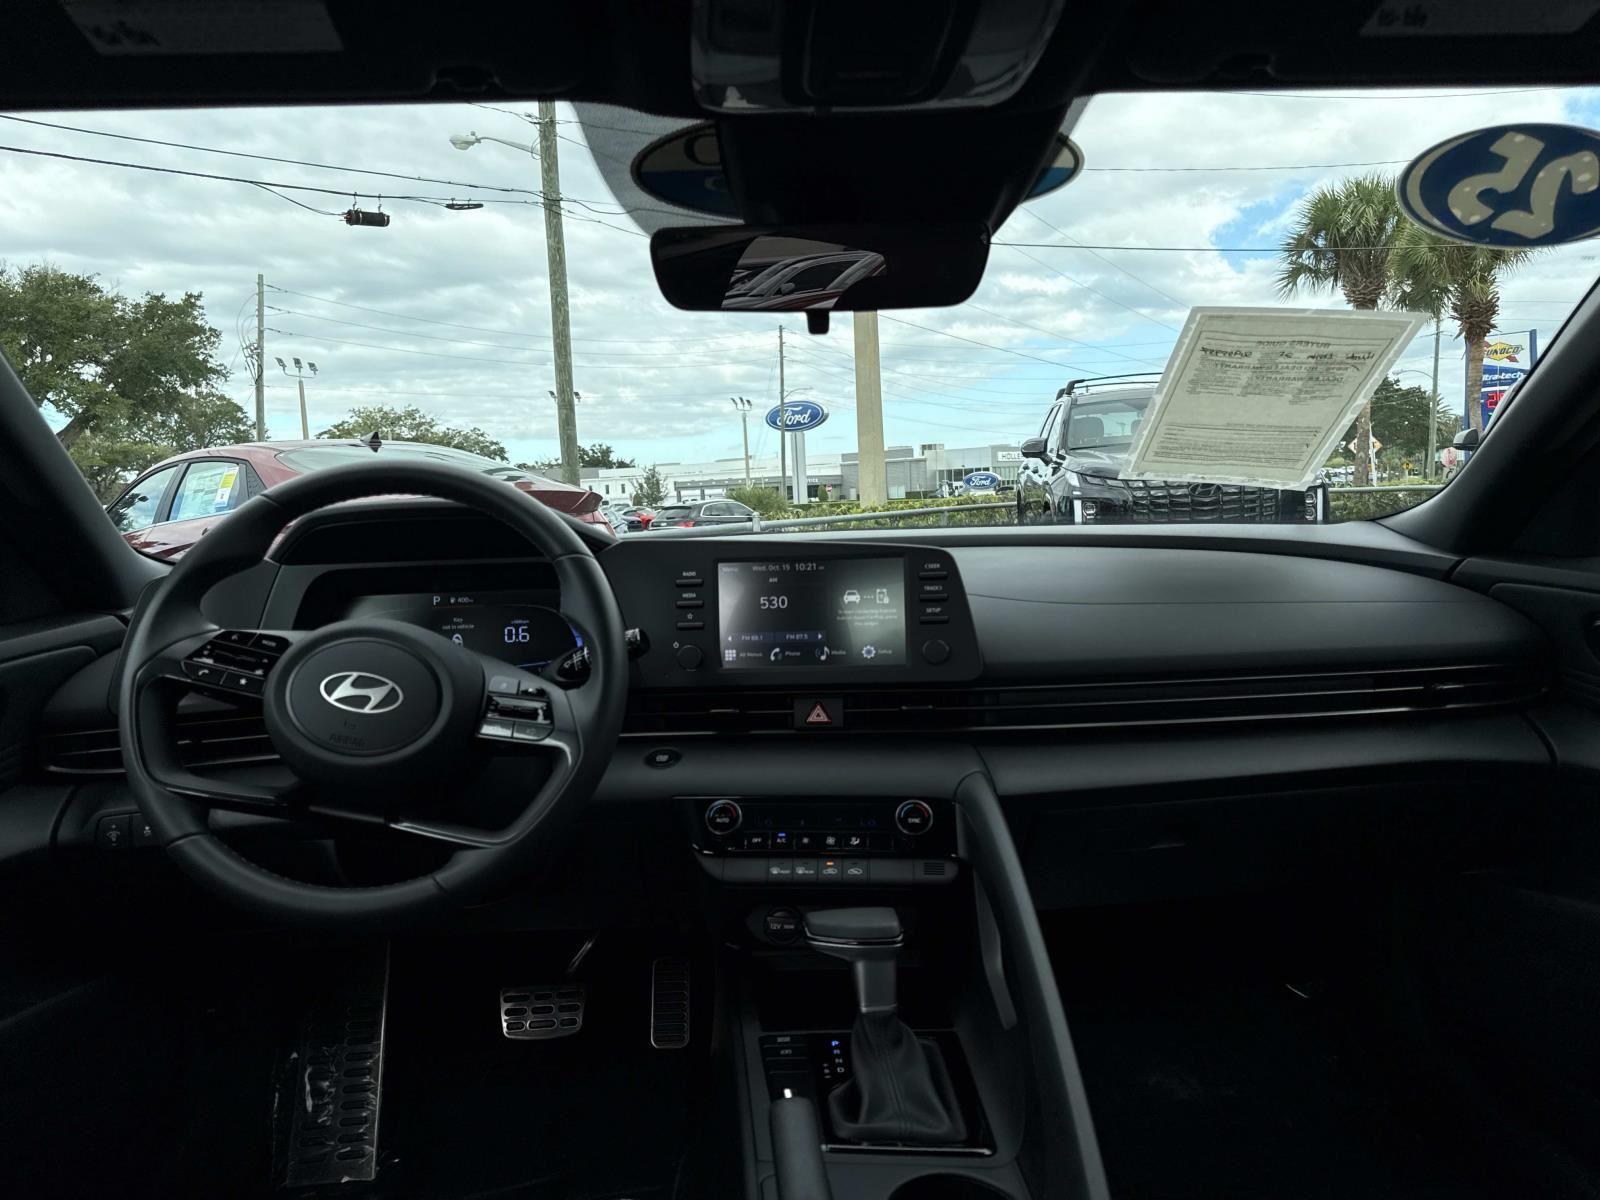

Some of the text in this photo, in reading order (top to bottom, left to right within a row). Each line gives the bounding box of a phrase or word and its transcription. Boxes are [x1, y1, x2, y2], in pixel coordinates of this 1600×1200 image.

[1484, 345, 1520, 355] UNOCO
[777, 406, 811, 425] Ford
[970, 475, 991, 486] Ford
[433, 596, 441, 606] P
[760, 595, 788, 609] 530
[504, 626, 530, 643] 0.6
